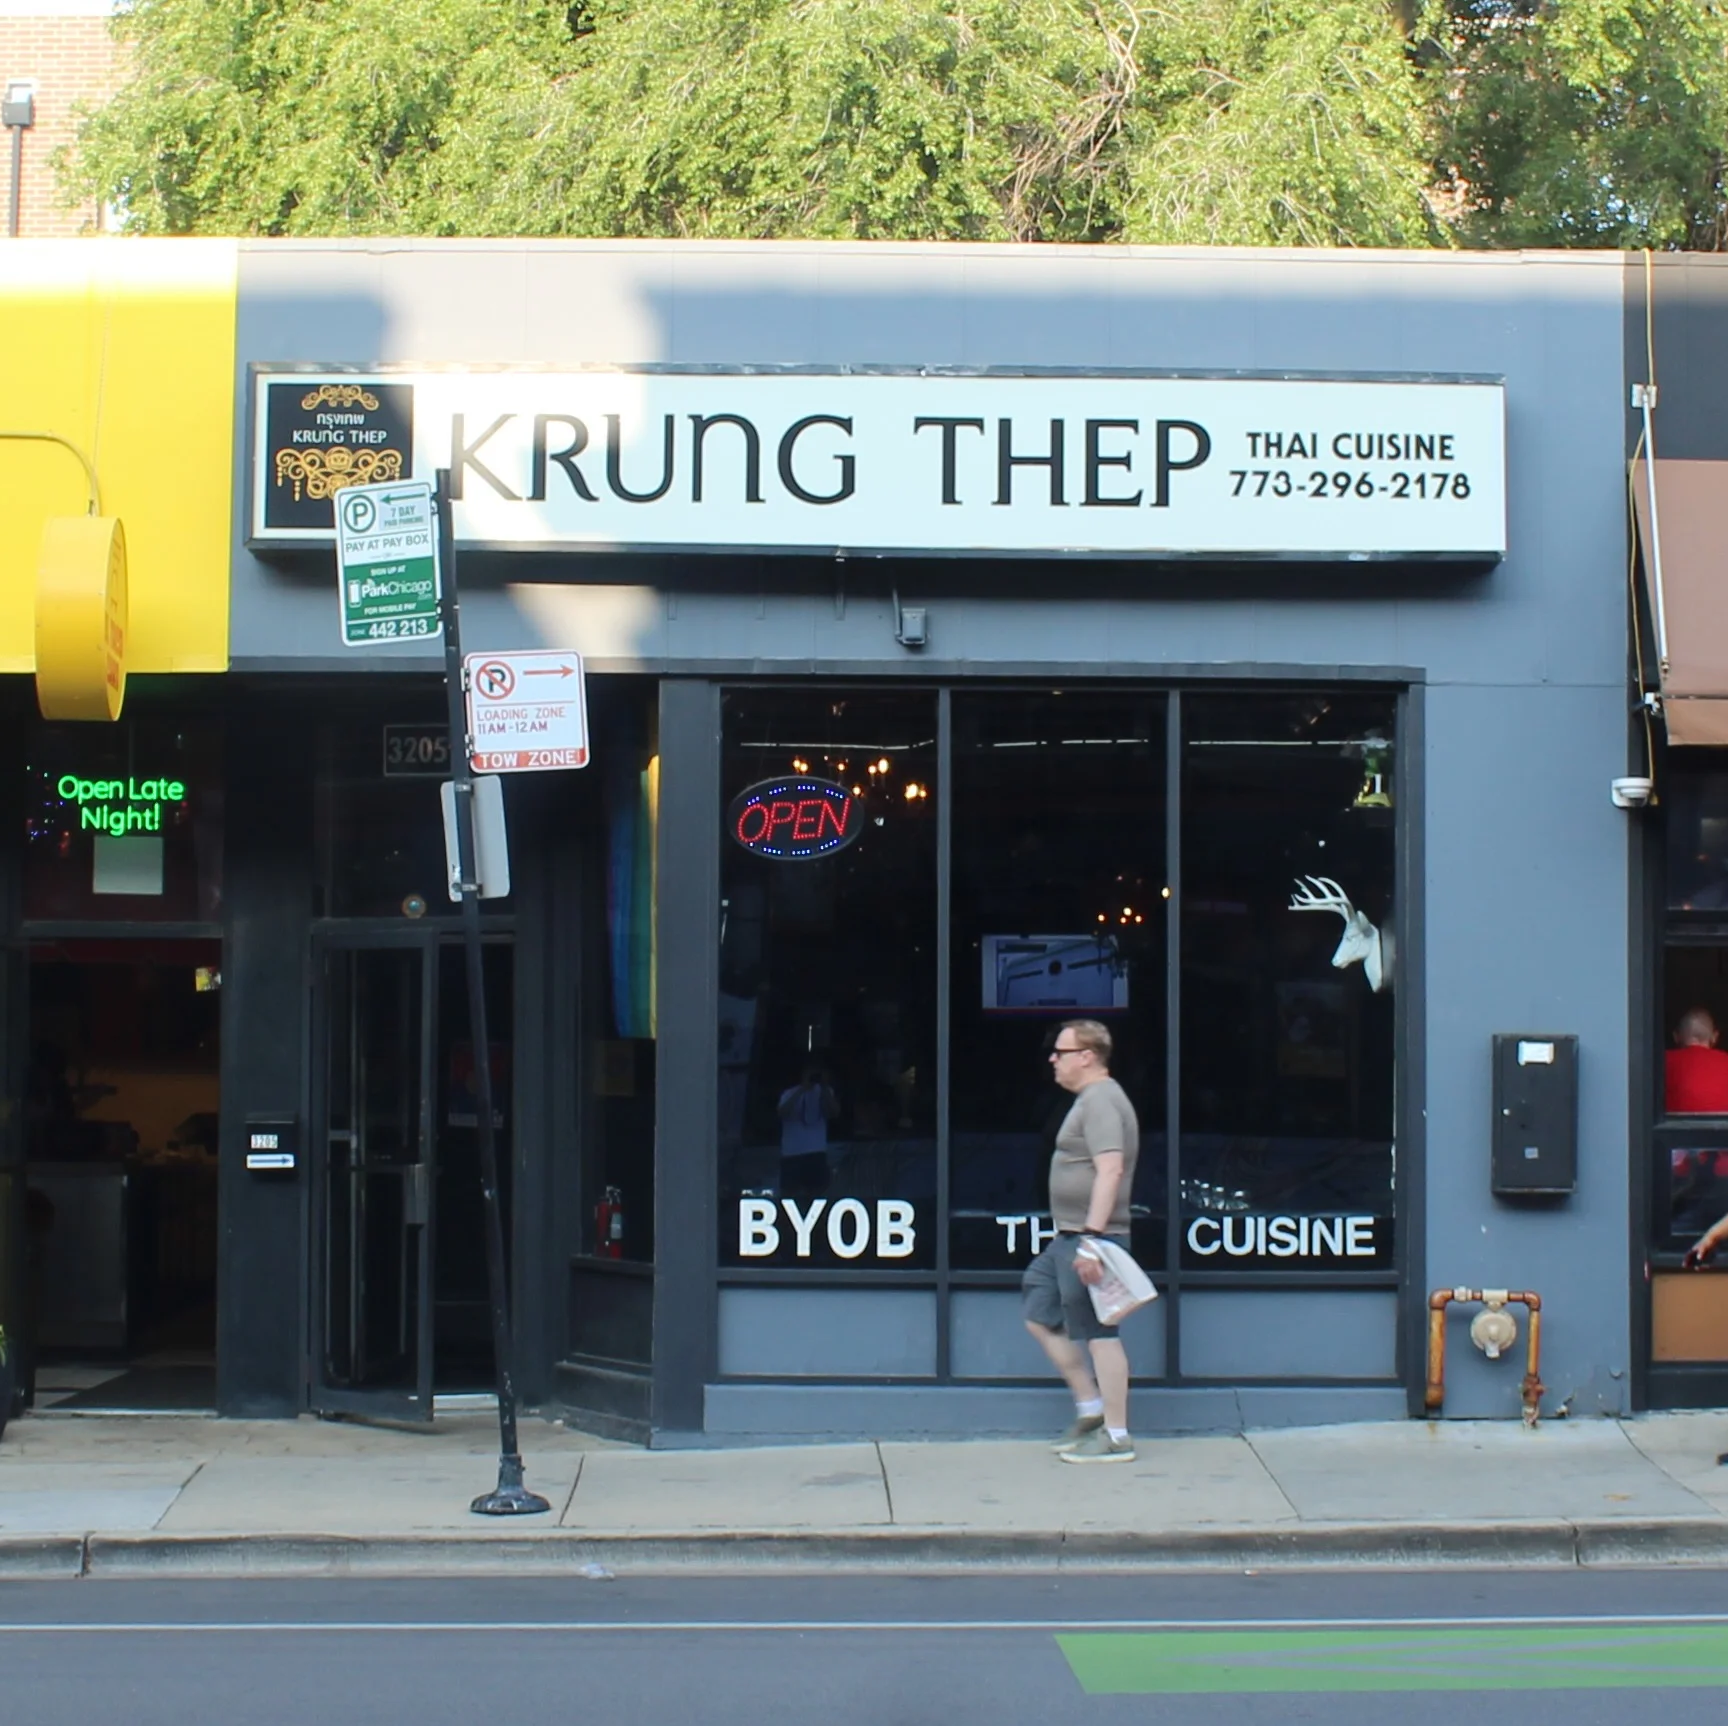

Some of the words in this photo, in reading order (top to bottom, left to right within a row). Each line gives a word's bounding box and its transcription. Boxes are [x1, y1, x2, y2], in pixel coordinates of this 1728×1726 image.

[349, 430, 388, 444] THEP
[1246, 432, 1318, 459] THAI
[1331, 433, 1455, 460] CUISINE
[448, 413, 856, 505] KRUNG
[913, 416, 1212, 507] THEP
[1229, 470, 1471, 500] 773-296-2178
[398, 505, 416, 517] DAY
[345, 541, 367, 552] PAY
[367, 539, 380, 549] AT
[382, 537, 403, 548] PAY
[405, 533, 429, 546] BOX
[387, 566, 397, 575] UP
[361, 580, 433, 598] ParkChicago
[379, 604, 403, 613] MOBILE
[369, 621, 396, 637] 442
[400, 618, 428, 635] 213
[477, 708, 529, 721] LOADING
[535, 706, 567, 720] ZONE
[480, 752, 518, 768] TOW
[528, 750, 577, 767] ZONE
[58, 775, 123, 804] Open
[128, 776, 185, 802] Late
[80, 802, 160, 837] Night!
[737, 798, 851, 843] OPEN
[739, 1197, 916, 1259] BYOB
[995, 1215, 1059, 1255] TH
[1187, 1216, 1376, 1256] CUISINE
